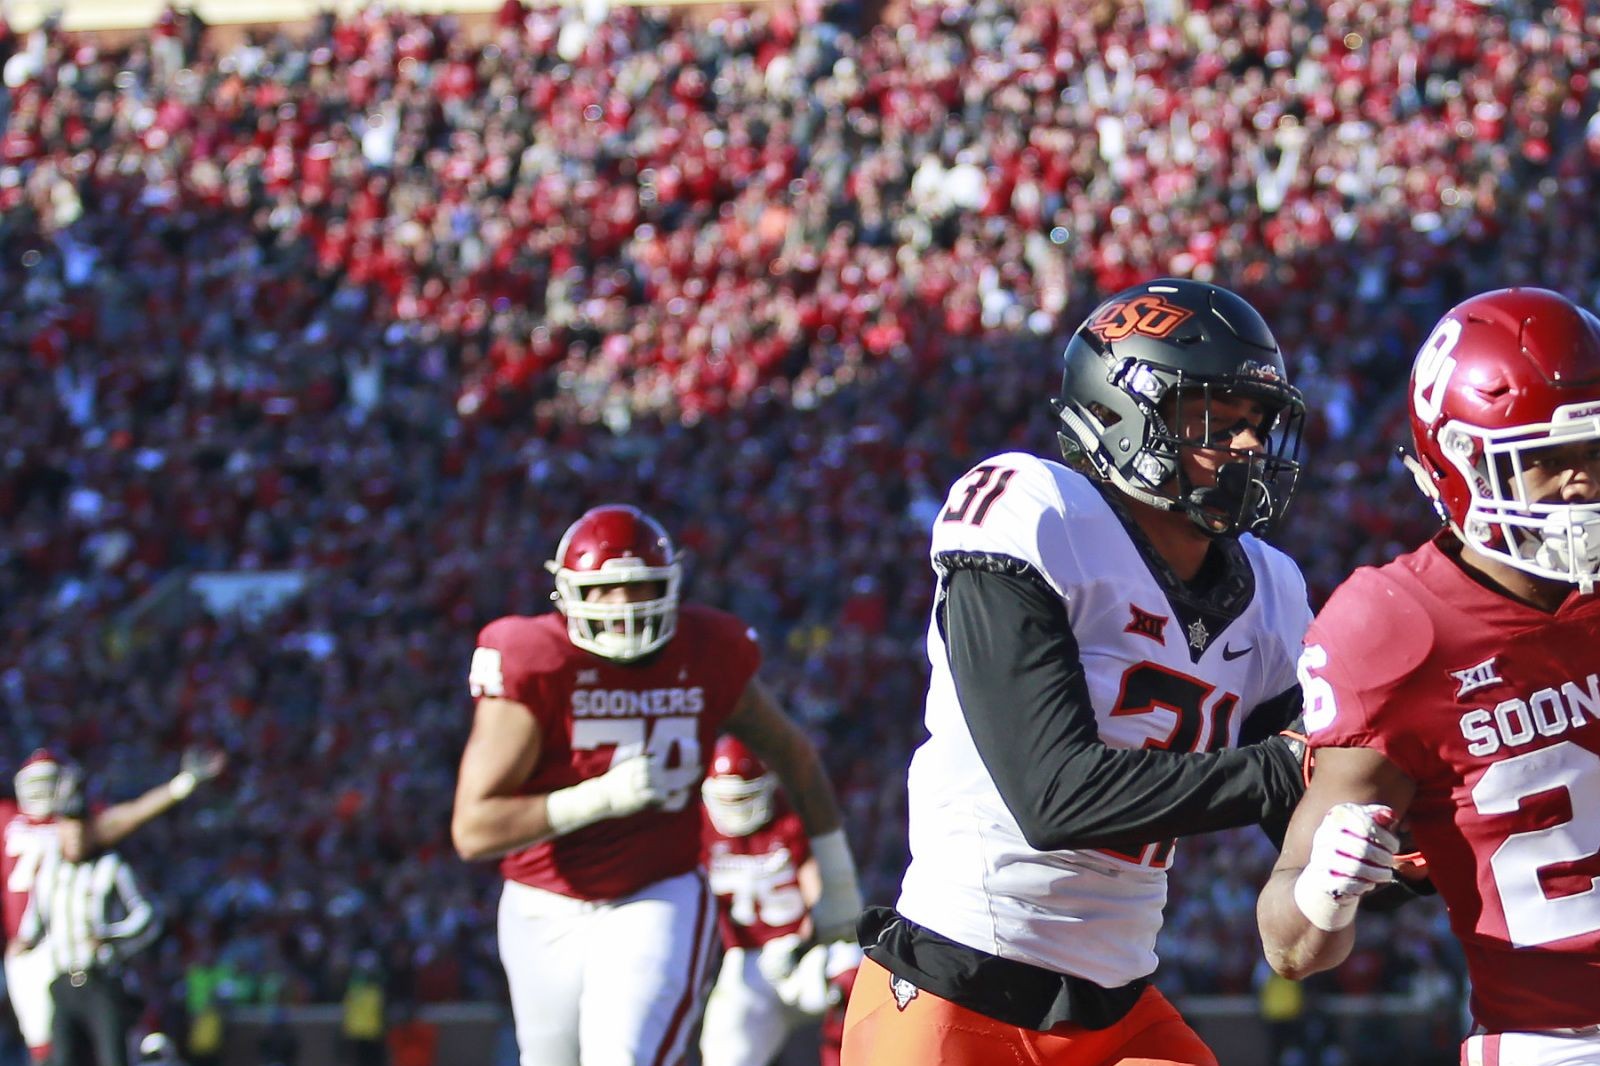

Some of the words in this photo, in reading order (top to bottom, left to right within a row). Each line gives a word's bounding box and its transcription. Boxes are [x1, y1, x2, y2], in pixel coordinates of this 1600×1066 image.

[1089, 295, 1194, 342] OSU
[1414, 318, 1462, 424] OU
[942, 466, 1017, 529] 31
[571, 686, 704, 717] SOONERS
[1450, 657, 1504, 698] XII
[709, 870, 804, 927] 75
